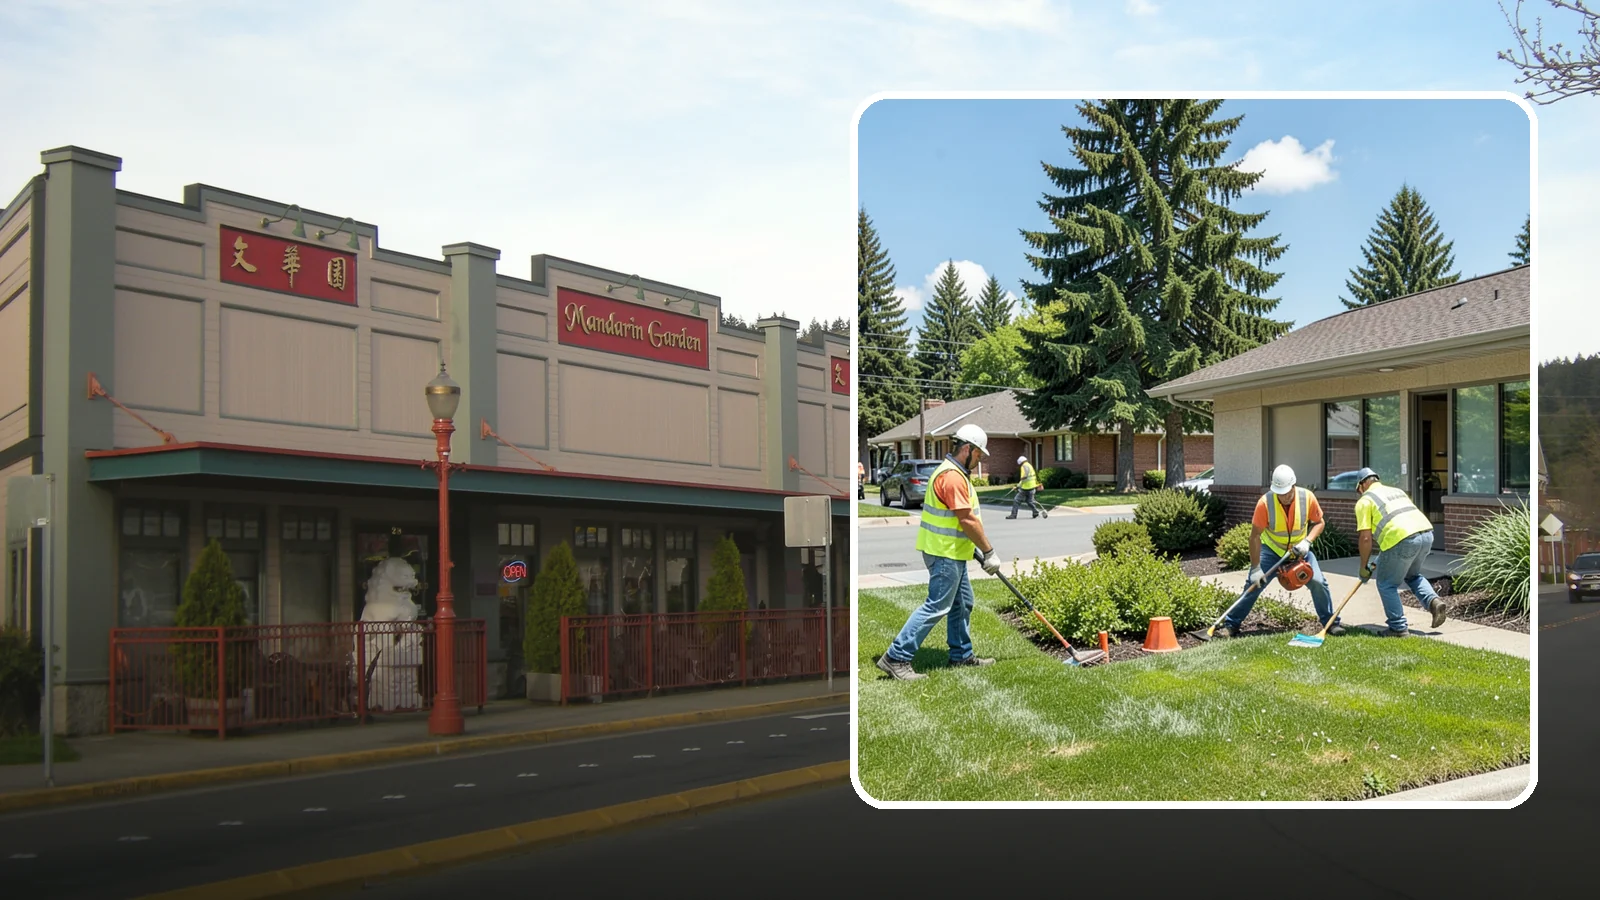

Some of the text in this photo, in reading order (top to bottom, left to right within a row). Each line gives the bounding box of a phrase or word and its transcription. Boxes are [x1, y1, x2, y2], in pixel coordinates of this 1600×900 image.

[231, 235, 346, 291] 文華園
[564, 302, 701, 352] Mandarin Garden
[834, 363, 846, 386] 文
[503, 565, 527, 578] OPEN
